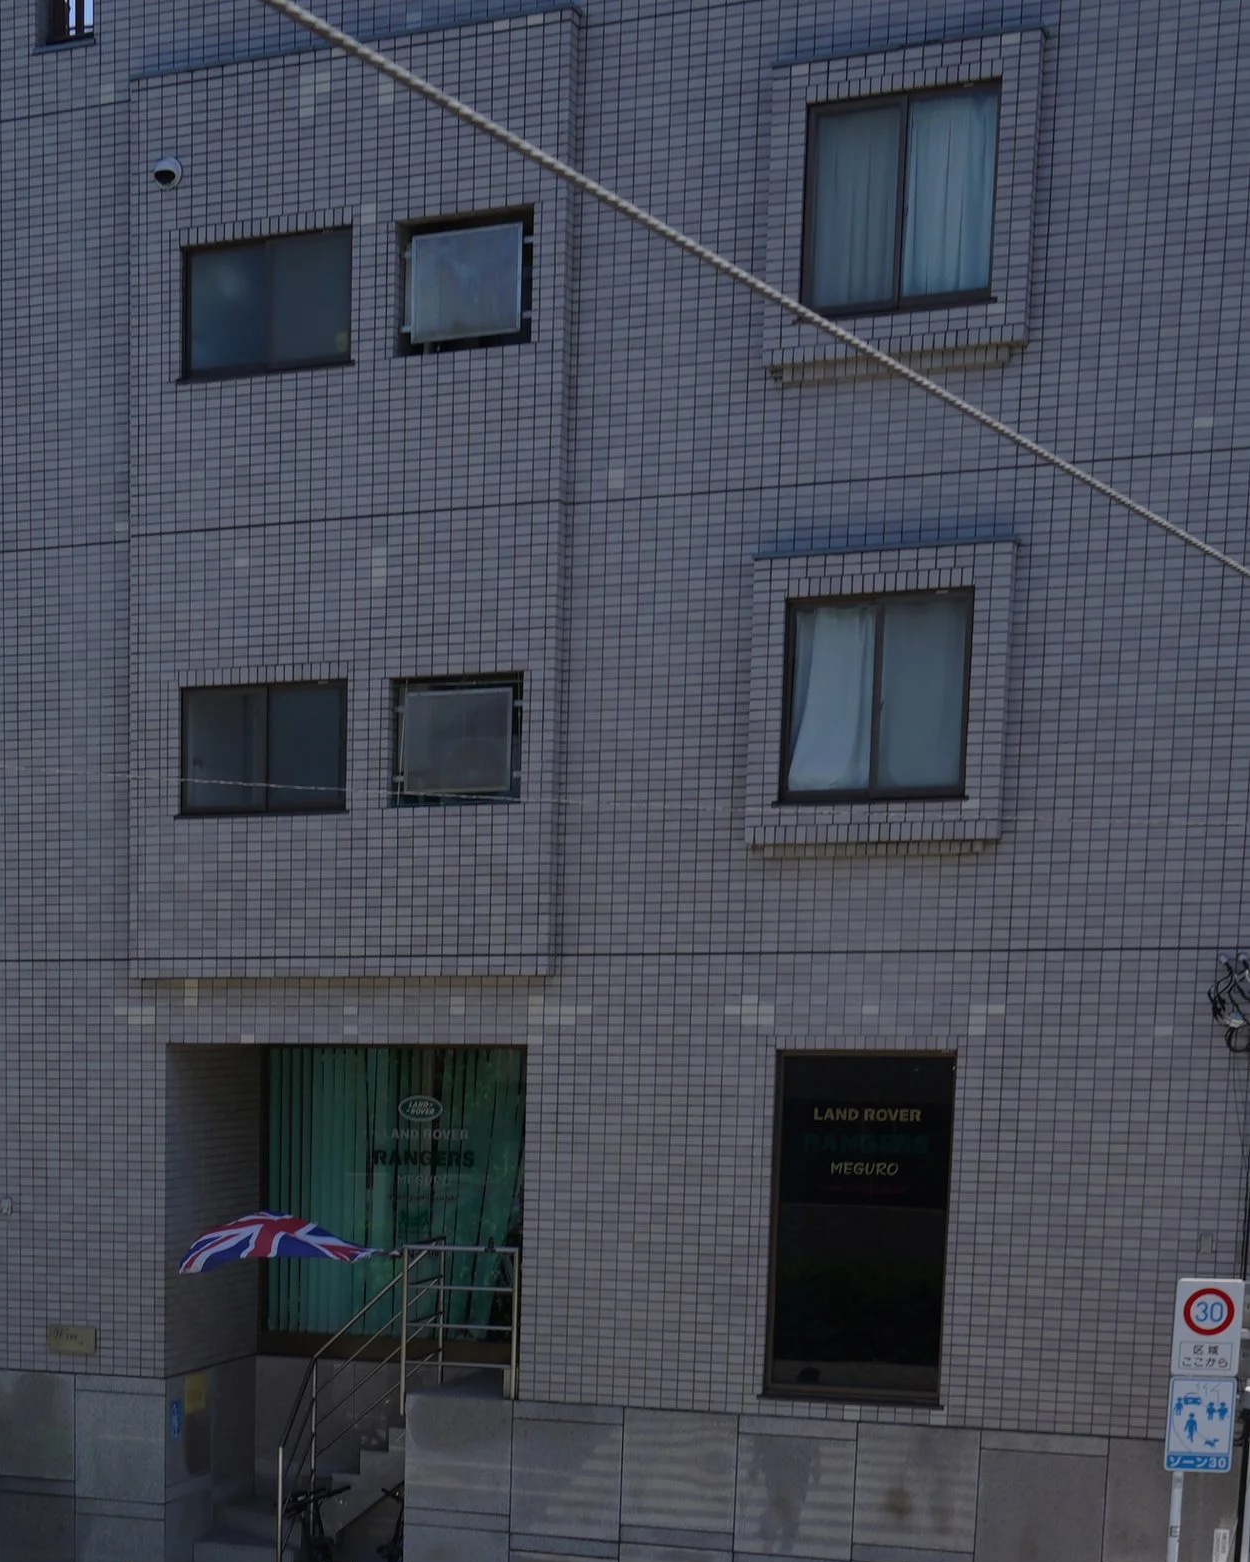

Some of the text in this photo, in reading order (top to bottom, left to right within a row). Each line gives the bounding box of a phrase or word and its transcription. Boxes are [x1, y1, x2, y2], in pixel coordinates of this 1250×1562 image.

[410, 1108, 435, 1116] ROVER
[813, 1107, 922, 1122] LAND ROVER
[423, 1128, 469, 1140] ROVER
[374, 1150, 475, 1167] RANGERS
[830, 1161, 899, 1176] MEGURO
[1195, 1300, 1223, 1322] 30
[1182, 1356, 1228, 1368] ここから
